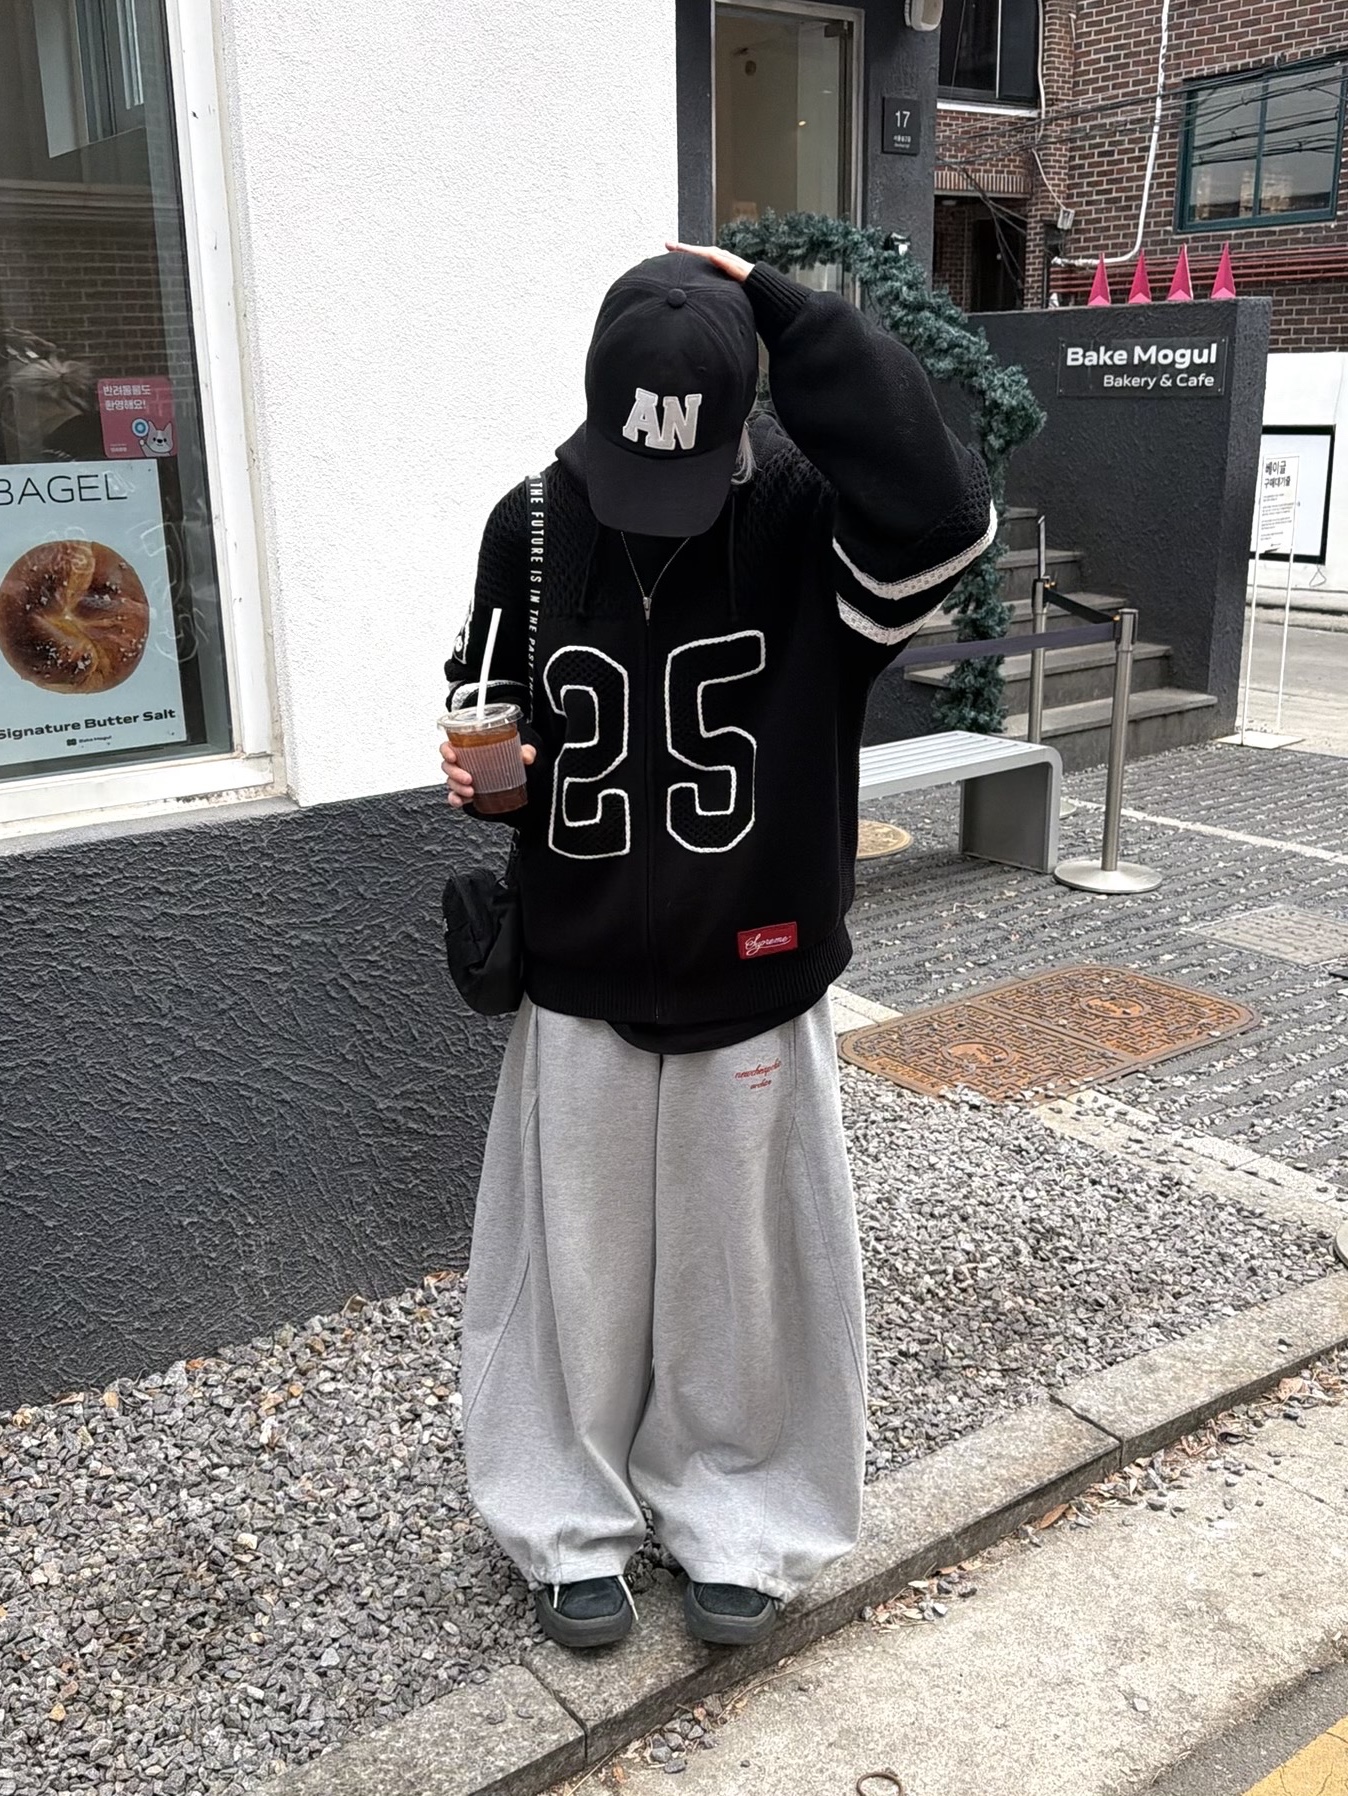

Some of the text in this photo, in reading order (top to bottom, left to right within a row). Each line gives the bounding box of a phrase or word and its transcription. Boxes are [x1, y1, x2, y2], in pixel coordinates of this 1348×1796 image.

[895, 110, 910, 128] 17
[1066, 343, 1218, 369] Bake Mogul
[1103, 373, 1215, 390] Bakery & Cafe
[622, 387, 702, 451] AN
[1265, 460, 1287, 476] 베이글
[0, 474, 128, 506] BAGEL
[530, 482, 544, 504] THE
[530, 511, 545, 563] FUTURE
[530, 570, 542, 583] IS
[529, 589, 541, 603] IN
[528, 609, 539, 633] THE
[527, 637, 536, 669] PAST
[0, 709, 176, 740] Signature Butter Salt
[542, 629, 766, 861] 25
